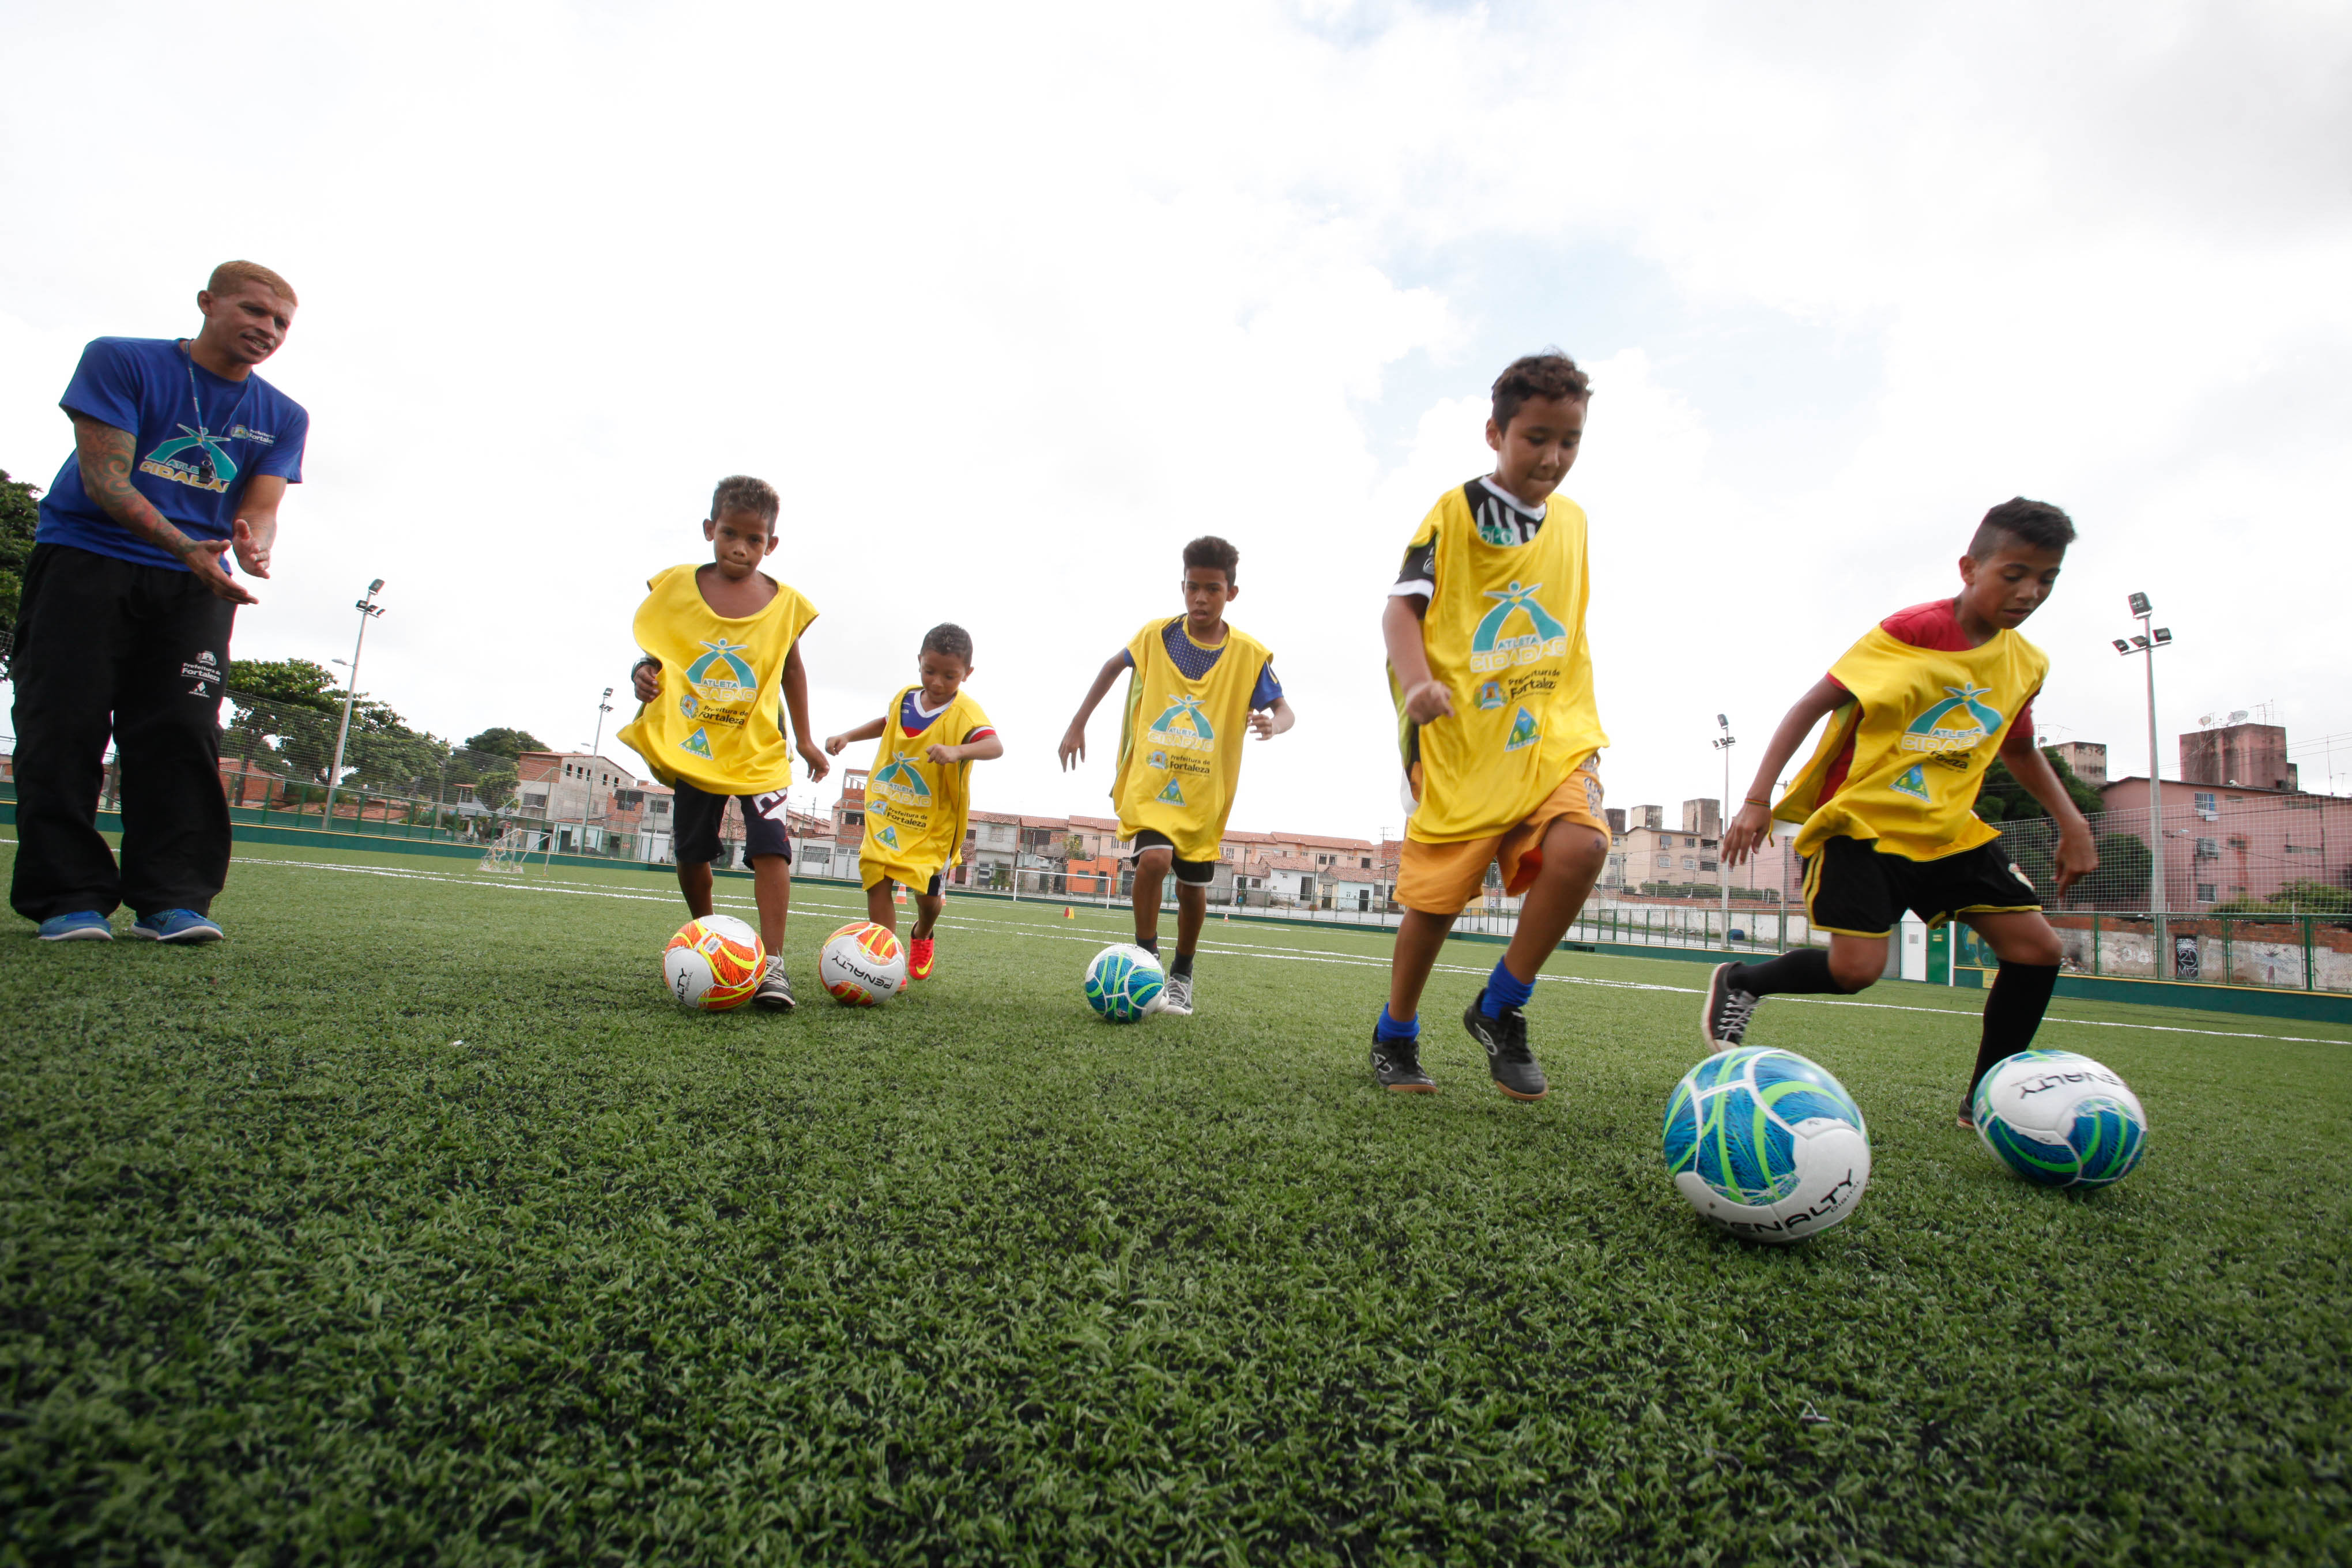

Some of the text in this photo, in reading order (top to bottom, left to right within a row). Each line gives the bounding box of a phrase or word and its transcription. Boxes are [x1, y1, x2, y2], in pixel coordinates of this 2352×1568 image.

[249, 434, 273, 444] Fortale
[140, 461, 229, 493] CIDADA
[1497, 635, 1540, 651] ATLETA
[183, 662, 215, 673] Prefeitura
[182, 668, 220, 682] Fortaleza
[702, 679, 740, 688] ATLETA
[704, 706, 737, 715] Preitura
[698, 711, 745, 725] Fortaleza
[1167, 727, 1198, 738] ATLETA
[1930, 726, 1986, 738] ATLETA
[1902, 734, 1978, 752] CIDAD
[1171, 755, 1201, 764] Prefeitura
[1170, 761, 1210, 774] Fortaleza
[889, 782, 914, 794] ATLETA
[888, 807, 918, 818] Prefeitura
[887, 812, 926, 828] Fortaleza
[832, 956, 893, 989] PENALTY
[677, 968, 687, 1002] ALTY
[685, 972, 693, 992] DIGITAL
